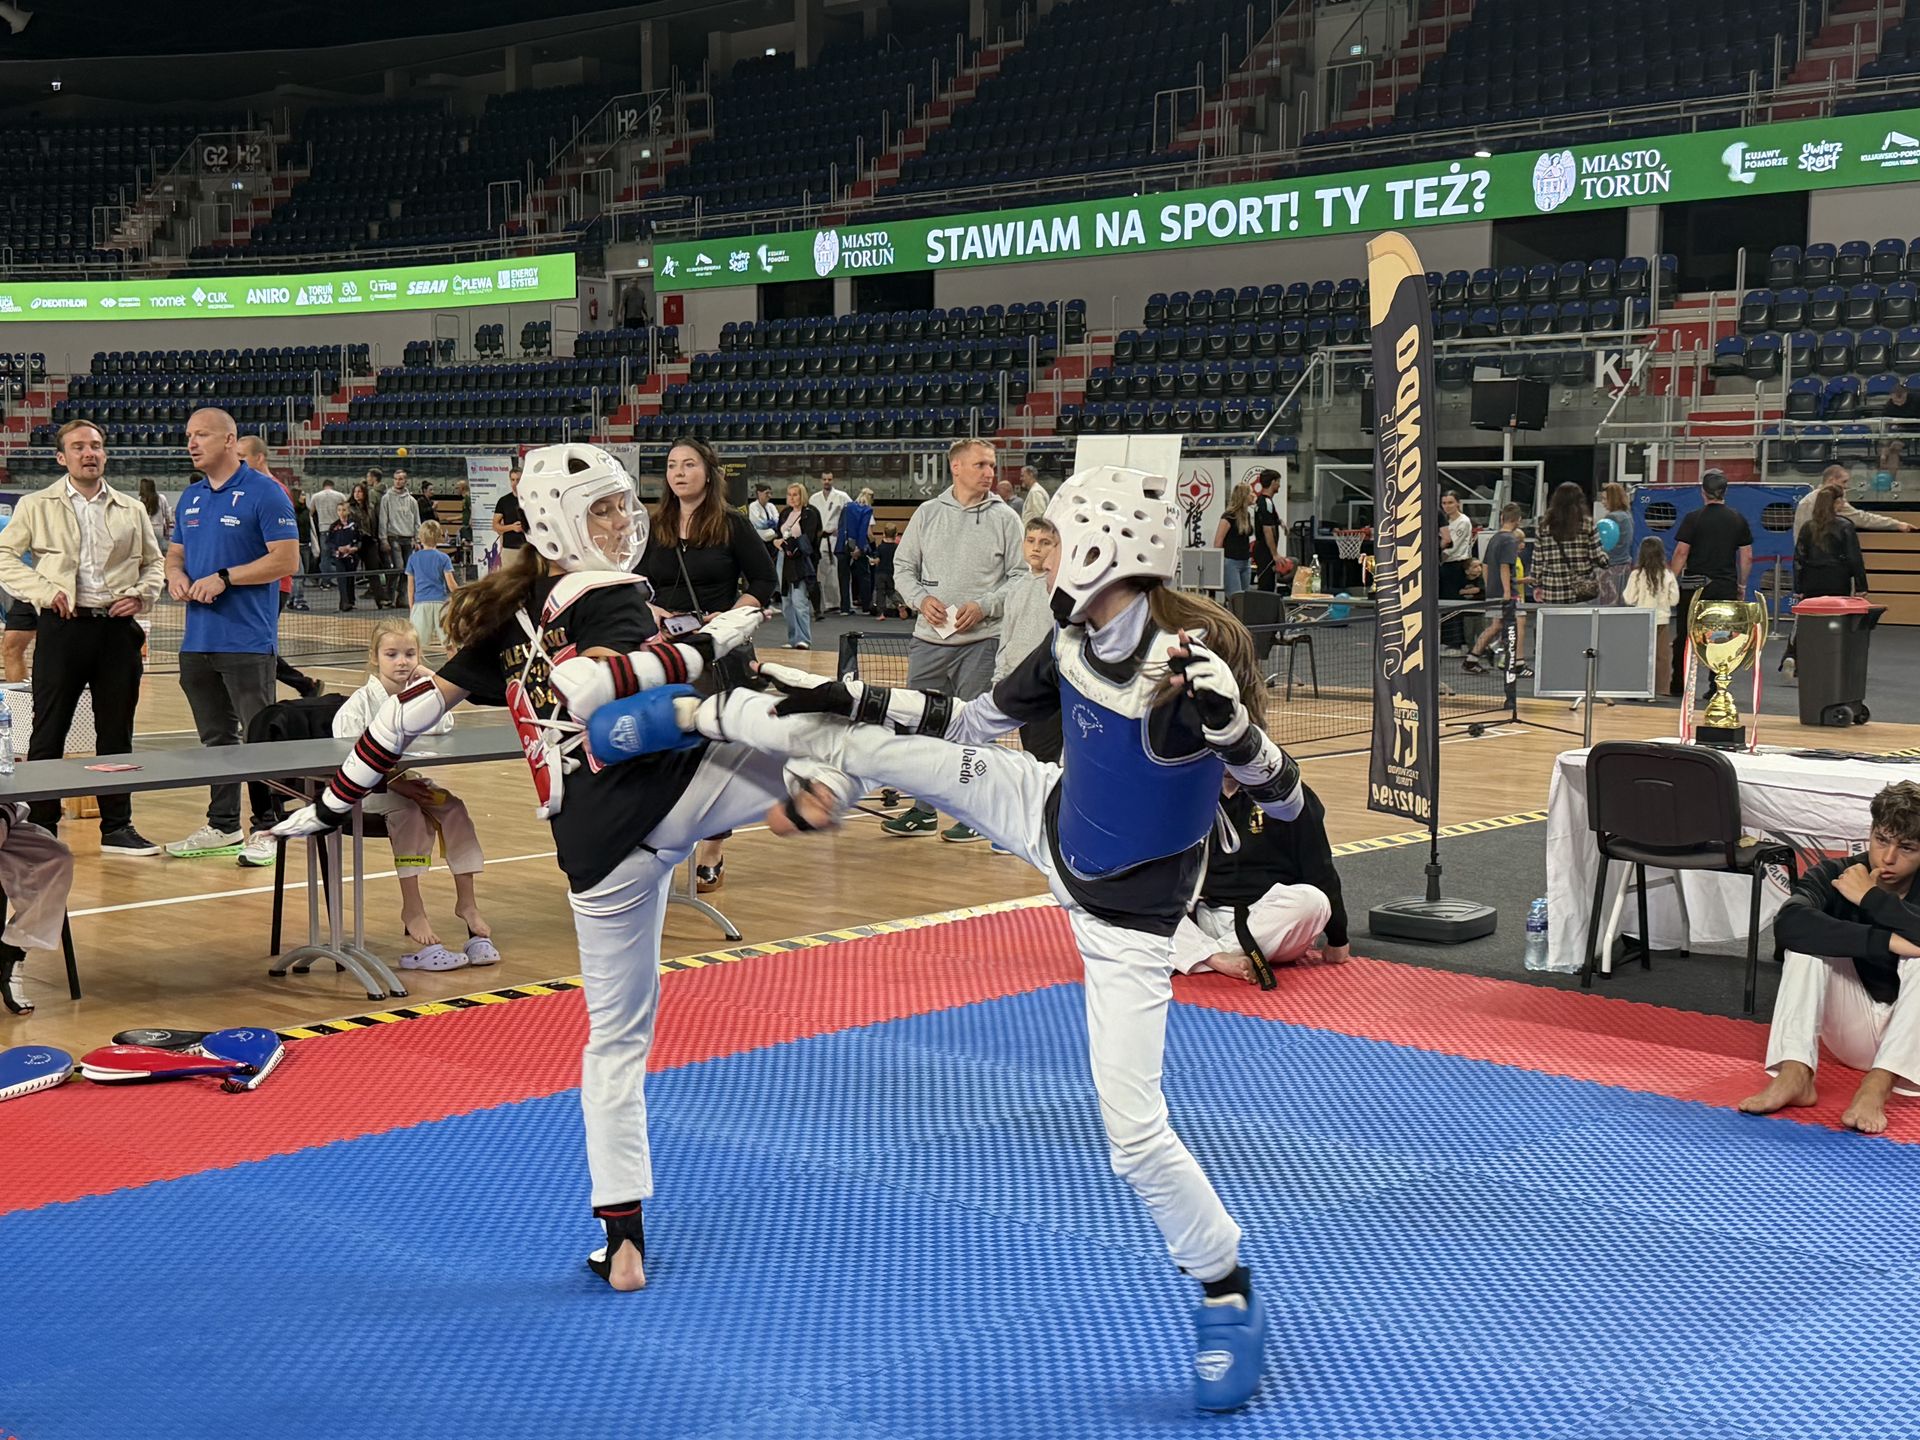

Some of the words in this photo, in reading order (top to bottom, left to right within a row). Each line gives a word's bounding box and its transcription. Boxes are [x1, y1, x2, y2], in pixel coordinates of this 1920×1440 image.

[618, 109, 639, 133] H2
[203, 146, 229, 166] G2
[237, 145, 262, 164] H2
[1744, 149, 1781, 160] KUJAWY
[1802, 140, 1843, 154] Uwierz
[1581, 148, 1661, 174] MIASTO
[1744, 157, 1789, 169] POMORZE
[1798, 151, 1840, 172] Sport
[1580, 164, 1672, 201] TORUŃ
[926, 214, 1081, 264] STAWIAM
[1095, 209, 1146, 249] NA
[1156, 190, 1300, 243] SPORT!
[1314, 183, 1370, 227] TY
[1385, 162, 1491, 221] TEŻ?
[841, 231, 889, 249] MIASTO
[841, 242, 895, 269] TORUŃ
[510, 267, 539, 280] ENERGY
[307, 282, 333, 296] TORUŃ
[405, 279, 449, 296] SEBAN
[462, 276, 493, 290] PLEWA
[510, 277, 539, 289] SYSTEM
[42, 298, 88, 308] DECATHLON
[207, 291, 228, 304] CUK
[245, 287, 291, 305] ANIRO
[308, 294, 333, 305] PLAZA
[1595, 350, 1642, 388] K1
[913, 453, 938, 486] J1
[1616, 442, 1659, 483] L1
[959, 748, 977, 785] Daedo
